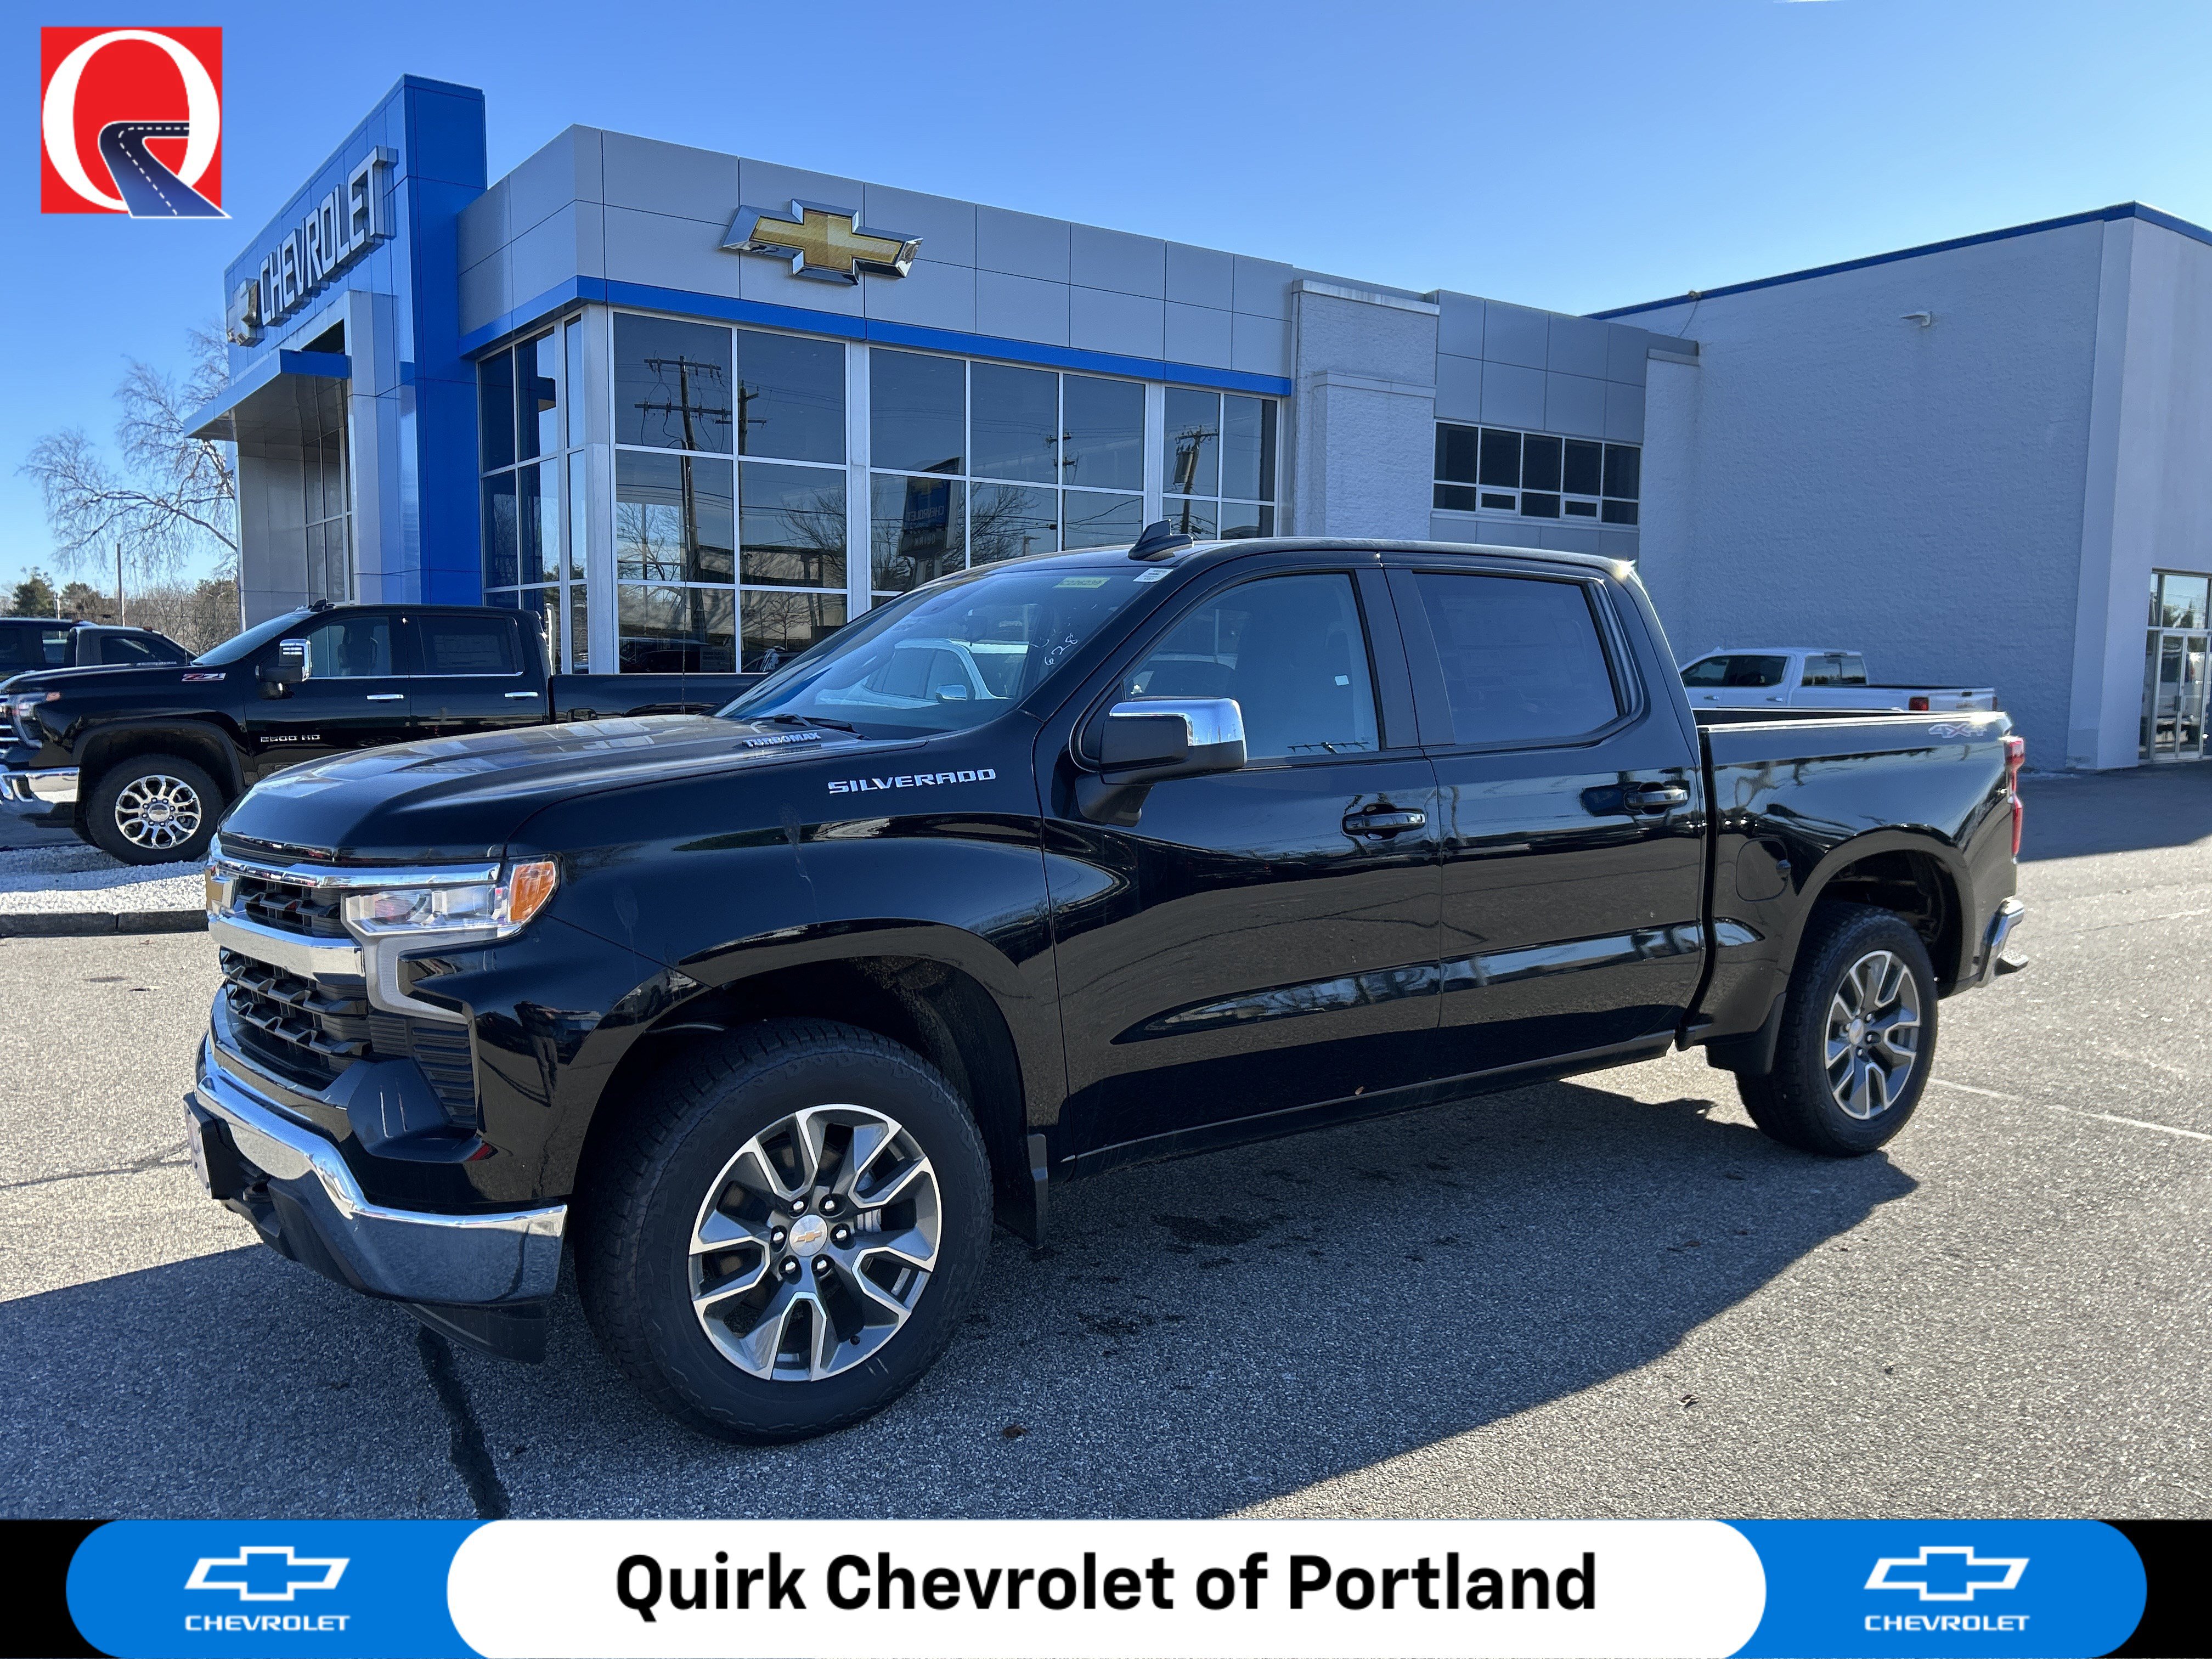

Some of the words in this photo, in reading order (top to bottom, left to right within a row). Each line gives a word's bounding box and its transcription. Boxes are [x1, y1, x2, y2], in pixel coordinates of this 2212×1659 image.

[259, 145, 398, 327] CHEVROLET
[1043, 632, 1078, 666] 628
[742, 732, 821, 748] TURBOMAX
[827, 768, 997, 794] SILVERADO
